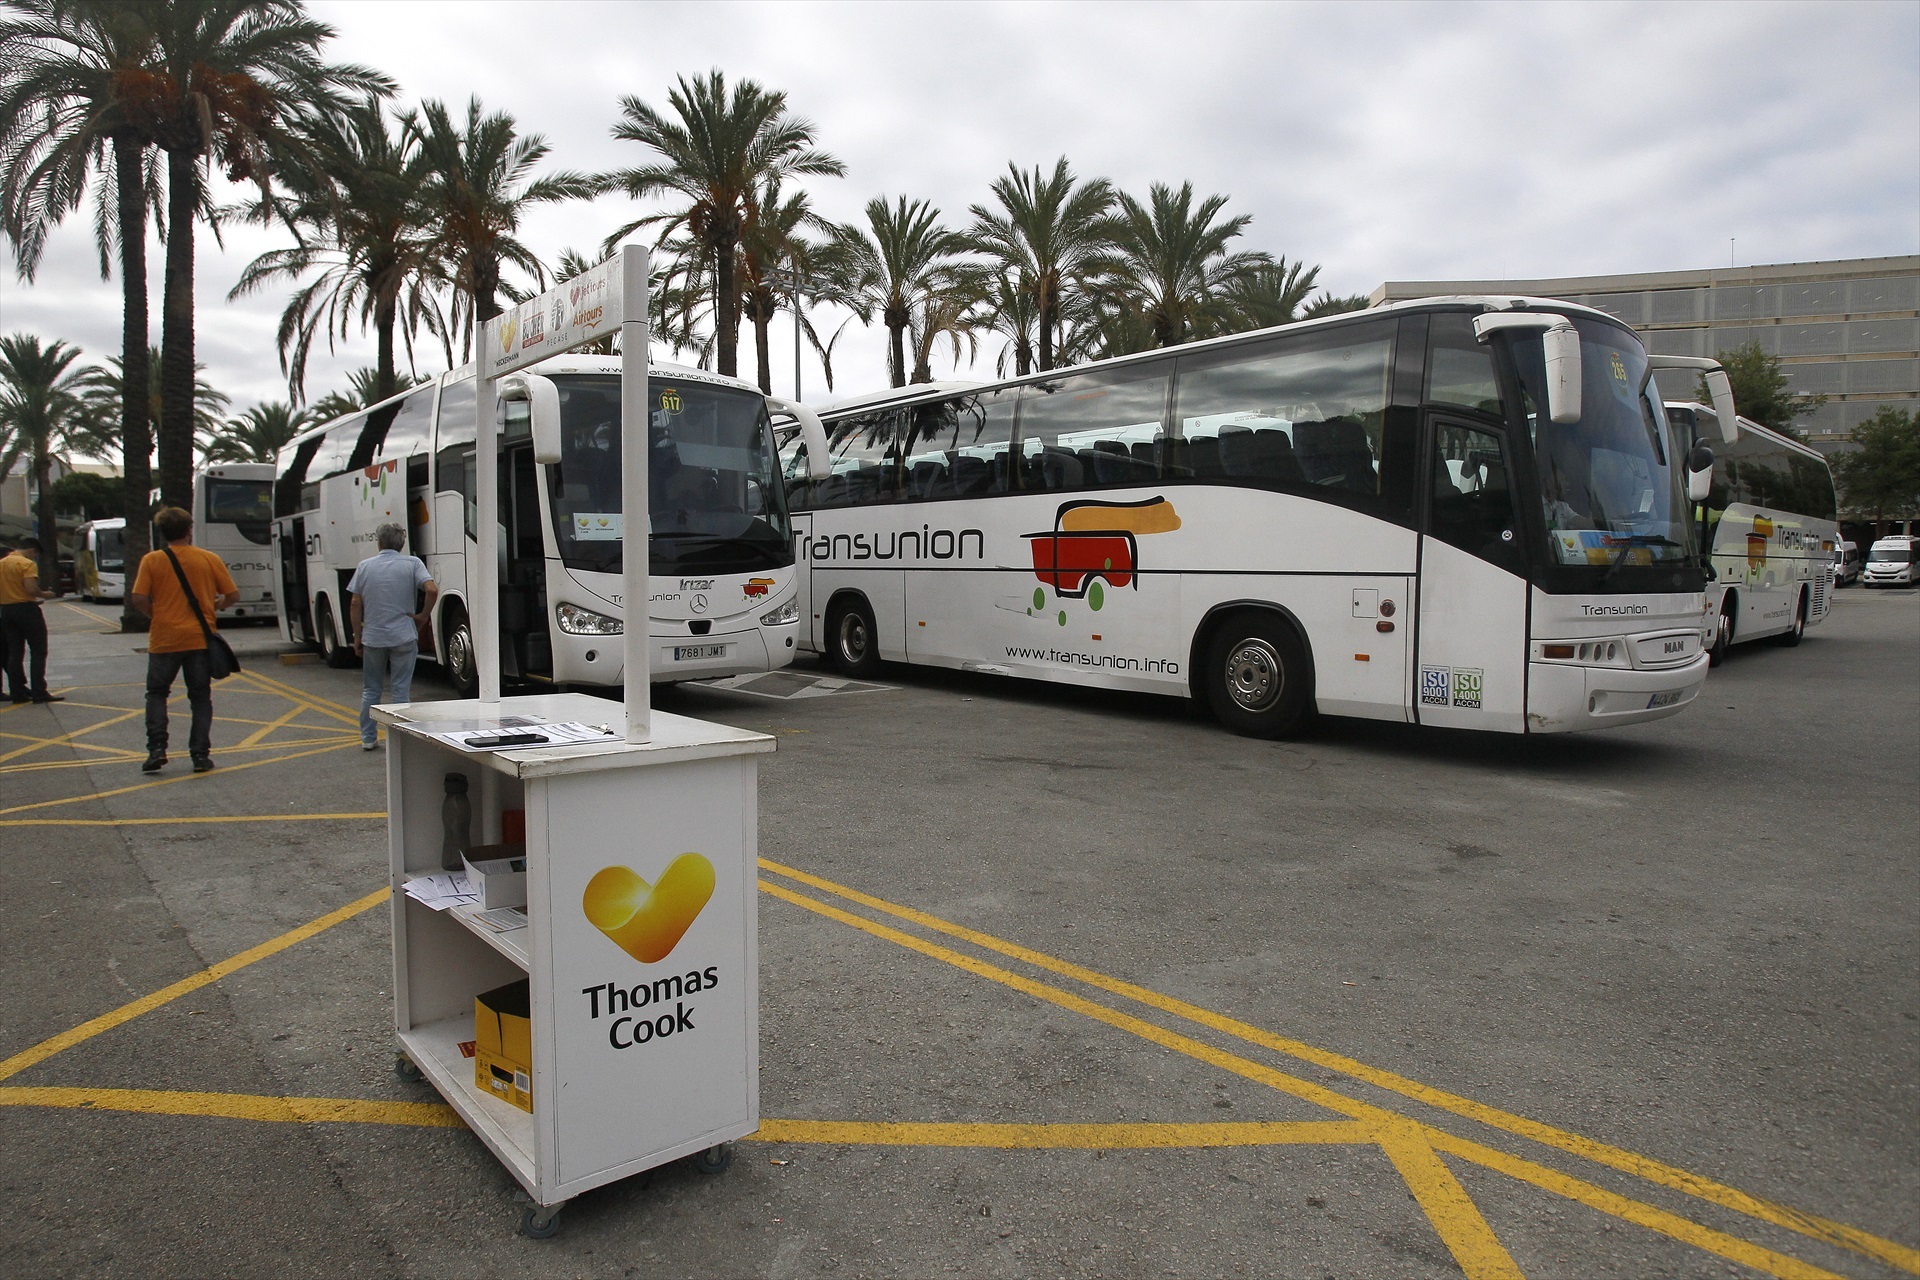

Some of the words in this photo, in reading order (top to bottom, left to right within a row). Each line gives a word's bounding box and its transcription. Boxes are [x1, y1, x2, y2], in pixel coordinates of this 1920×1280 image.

[572, 305, 603, 327] Airtours
[662, 395, 680, 410] 617
[1777, 524, 1820, 551] Transunion
[679, 578, 715, 591] Irizar
[1581, 603, 1649, 616] Transunion
[680, 647, 704, 659] 7681
[707, 645, 725, 657] JMT
[1664, 640, 1685, 654] MAN
[1005, 643, 1180, 675] www.transunion.info
[1423, 671, 1448, 687] ISO
[1454, 674, 1481, 690] ISO
[1423, 687, 1447, 697] 9001
[1453, 690, 1481, 700] 14001
[1423, 696, 1447, 705] ACCM
[1455, 699, 1480, 708] ACCM
[582, 966, 719, 1019] Thomas
[609, 1001, 696, 1050] Cook
